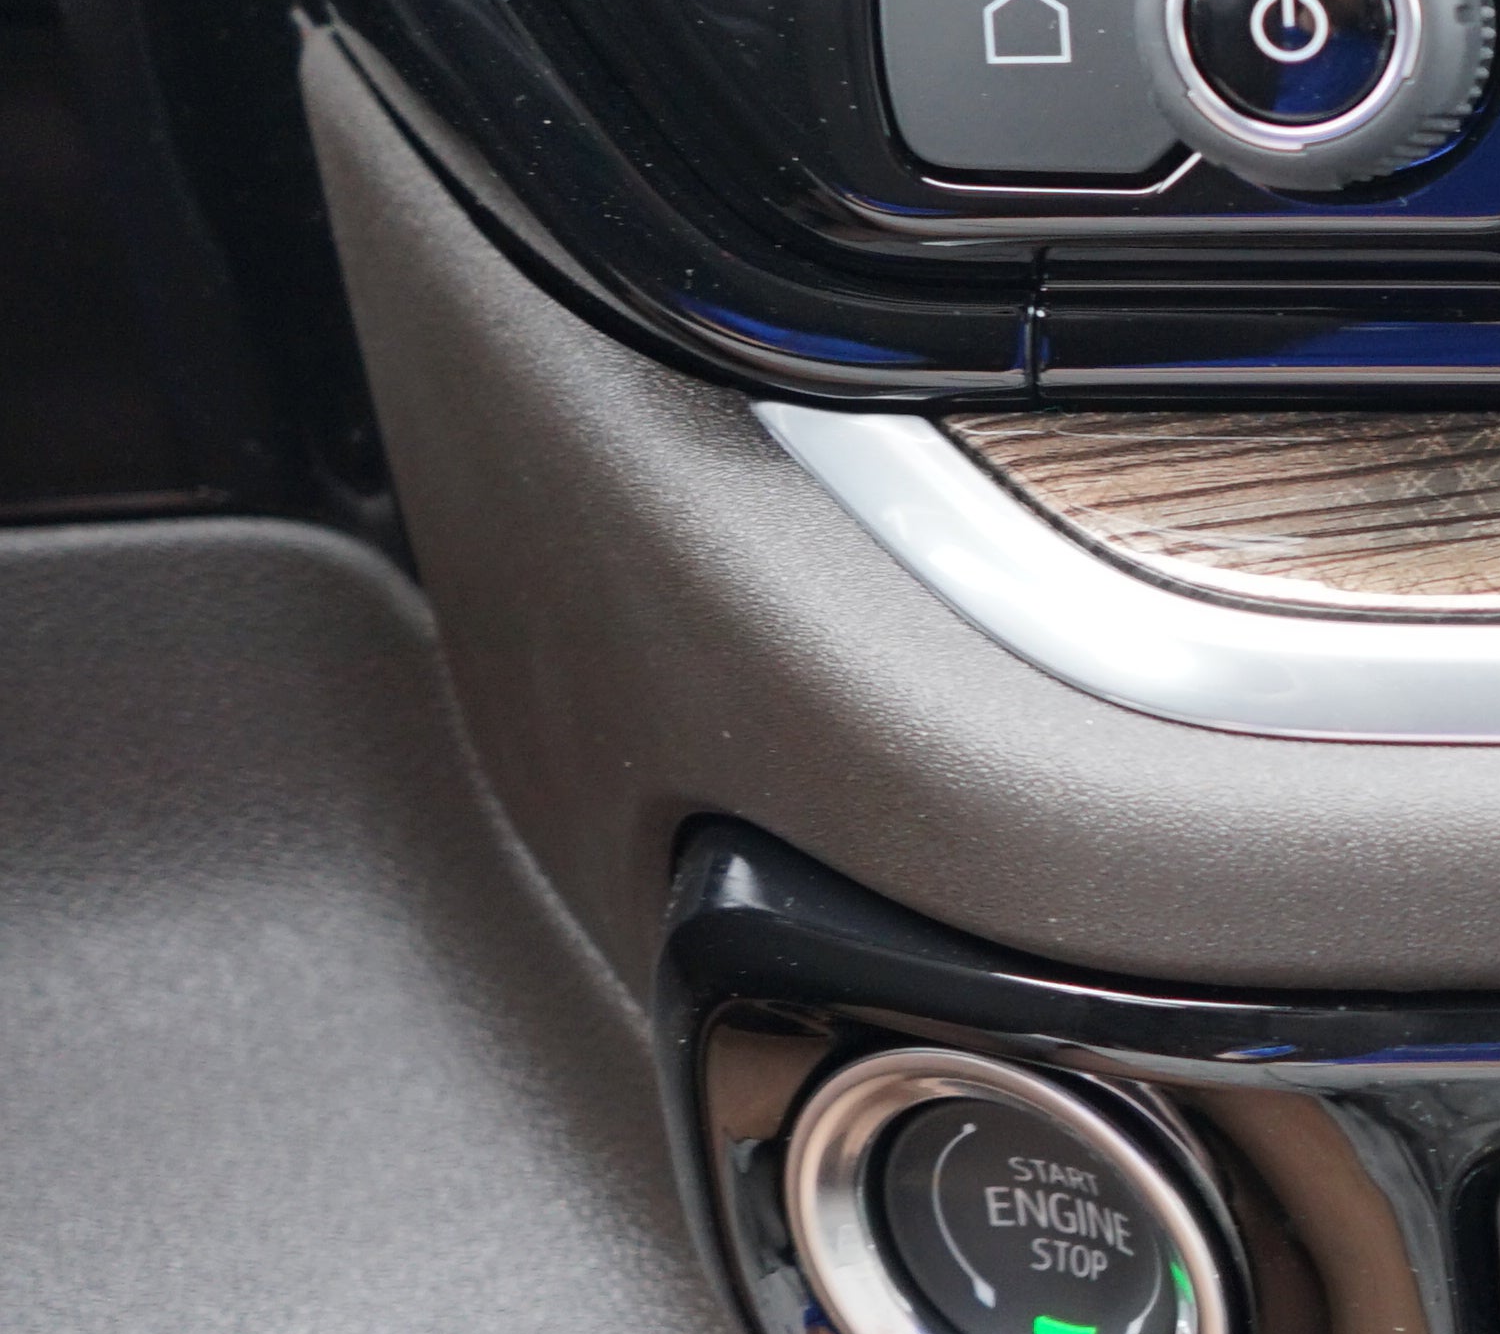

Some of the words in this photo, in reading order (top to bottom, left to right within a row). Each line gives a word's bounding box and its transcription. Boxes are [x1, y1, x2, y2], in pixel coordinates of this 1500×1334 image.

[1009, 1156, 1098, 1194] START
[985, 1186, 1133, 1256] ENGINE
[1030, 1237, 1108, 1281] STOP
